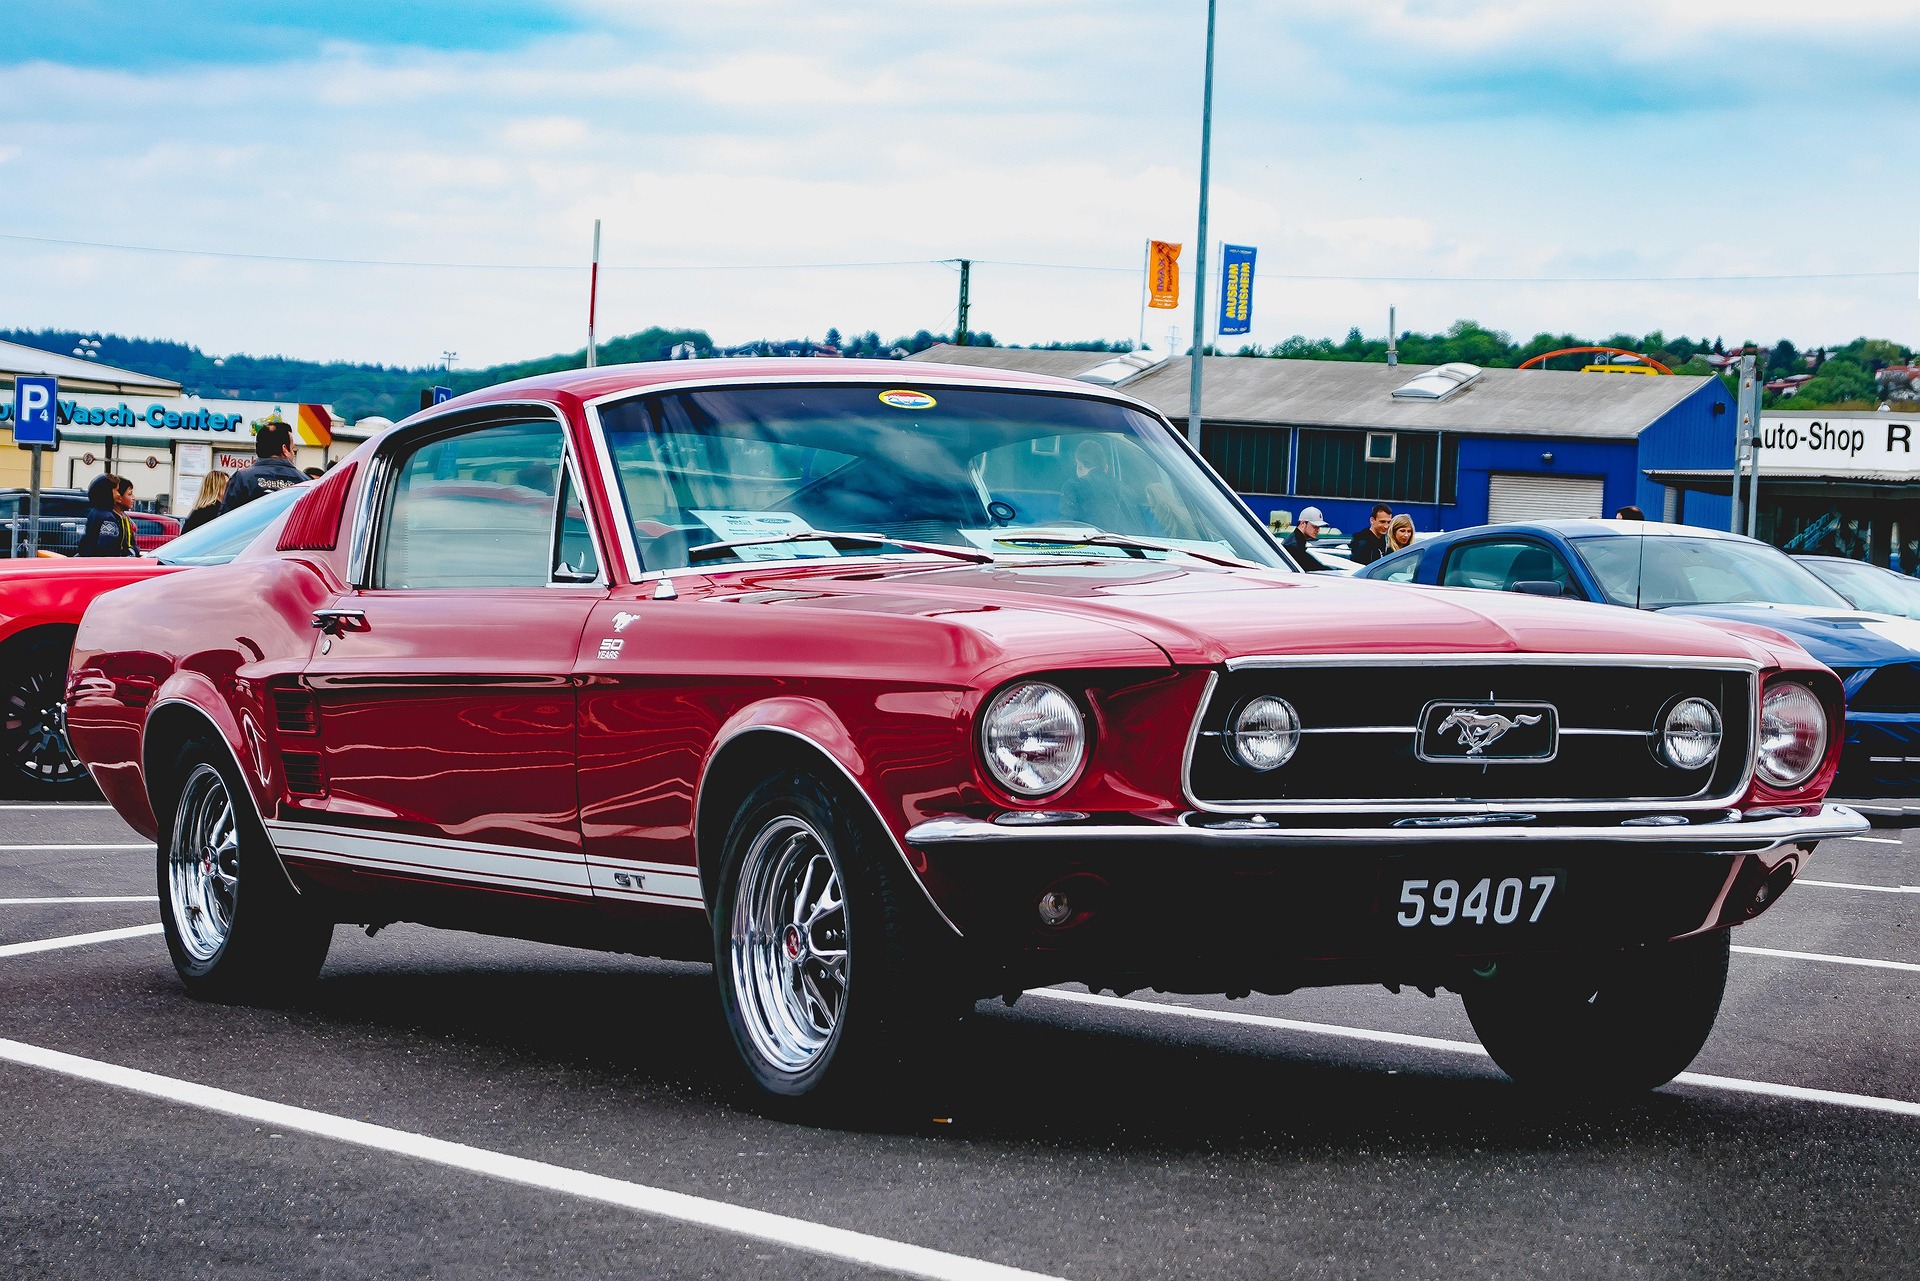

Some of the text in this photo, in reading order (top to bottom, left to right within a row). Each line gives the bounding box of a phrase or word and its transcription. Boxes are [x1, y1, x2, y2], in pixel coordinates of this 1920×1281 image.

[1225, 263, 1238, 318] MUSEUM
[1237, 262, 1250, 321] SINSHEIM
[1760, 421, 1911, 457] uto-Shop R
[597, 650, 619, 659] YEARS
[600, 638, 624, 650] 50
[614, 872, 645, 889] GT
[1397, 875, 1556, 927] 59407
